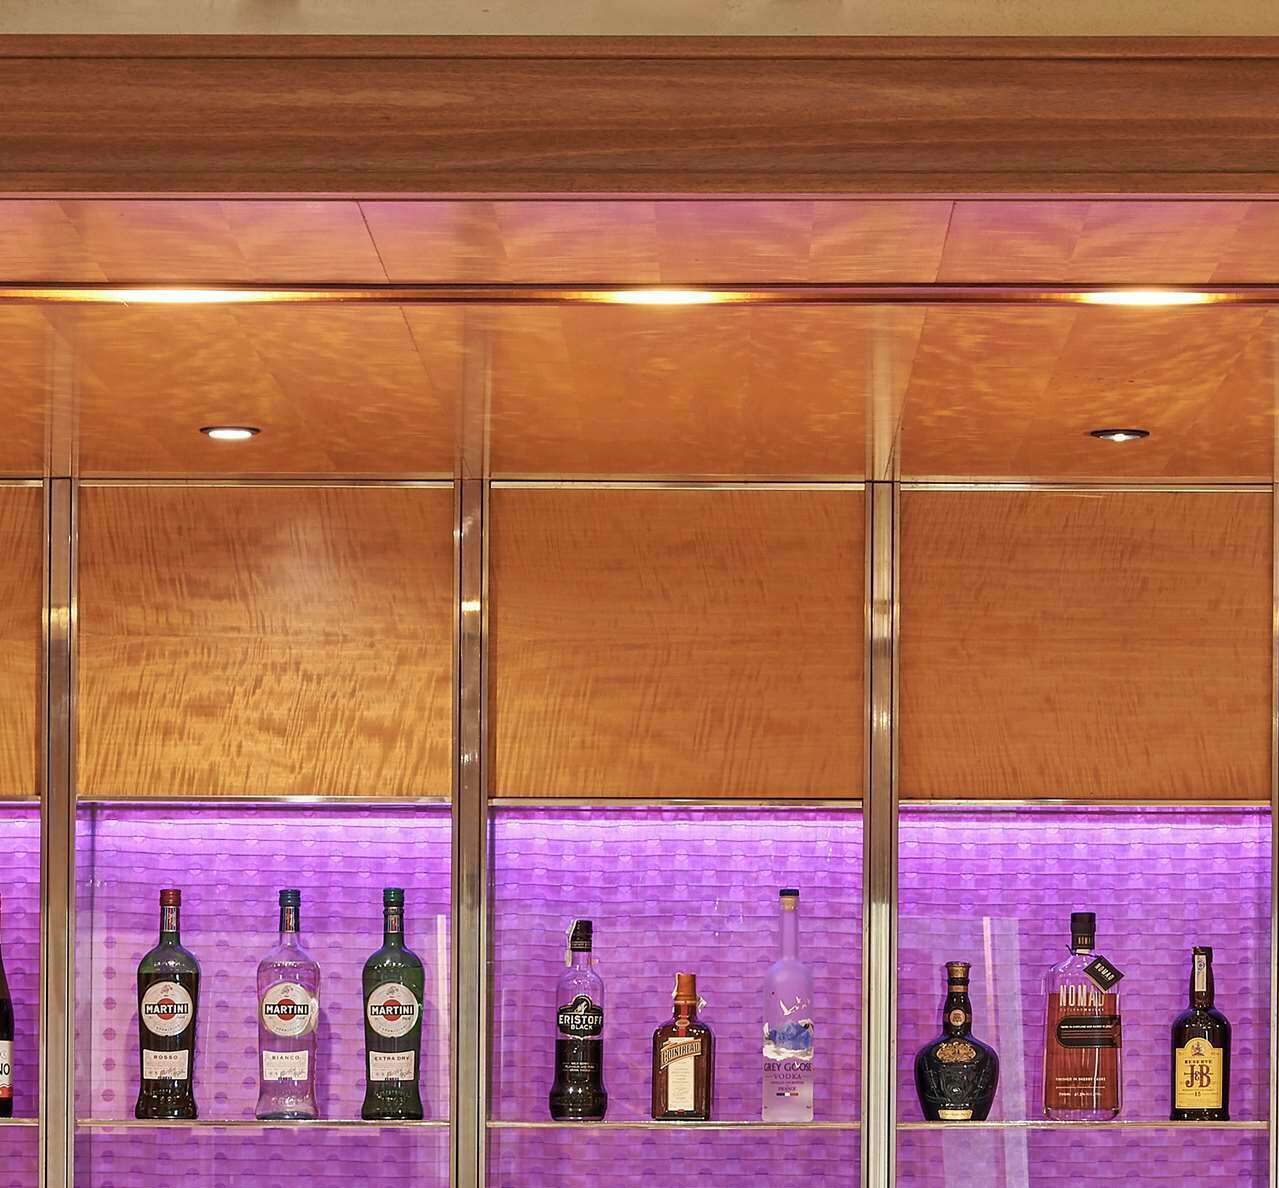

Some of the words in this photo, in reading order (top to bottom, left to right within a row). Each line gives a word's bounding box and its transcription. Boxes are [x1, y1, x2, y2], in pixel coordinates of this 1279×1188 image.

[1060, 984, 1105, 1007] NOMAD
[146, 1004, 188, 1014] MARTINI
[266, 1005, 308, 1014] MARTINI
[371, 1006, 413, 1015] MARTINI
[558, 1014, 602, 1025] ERISTOFF
[662, 1042, 699, 1063] COINTREAU
[1184, 1064, 1211, 1088] J&B
